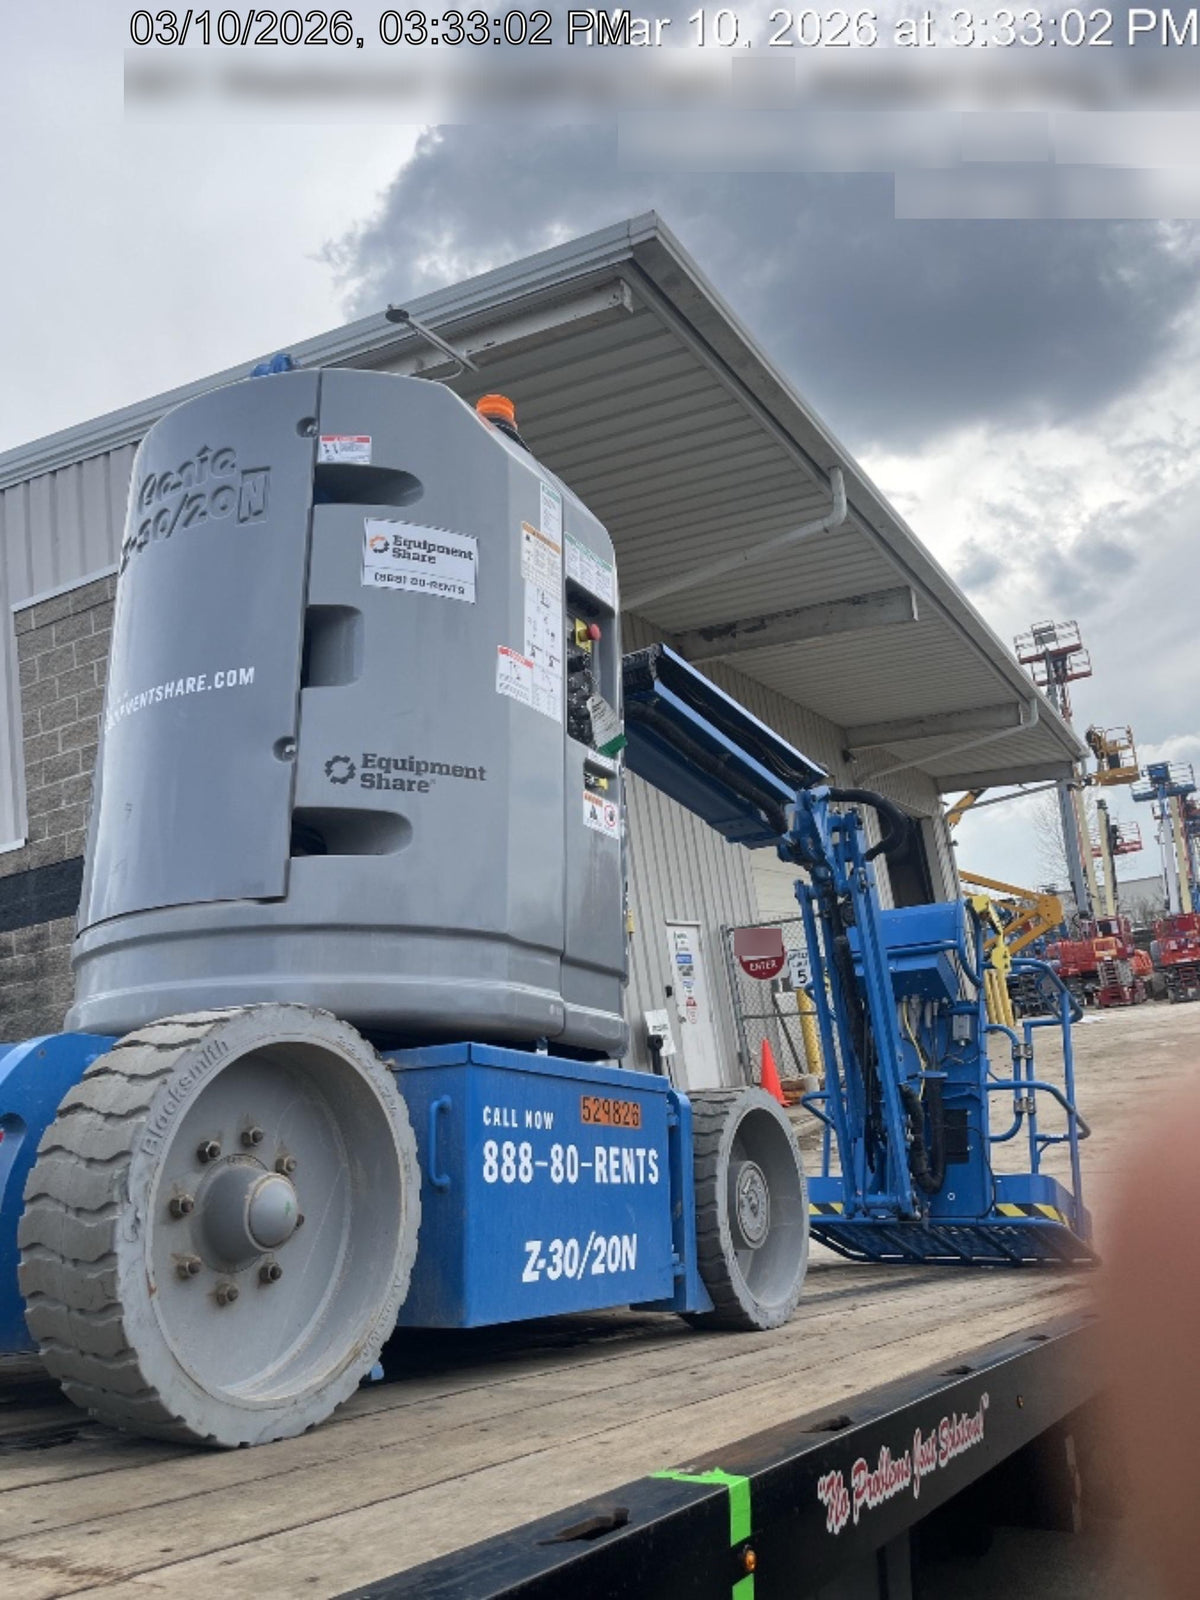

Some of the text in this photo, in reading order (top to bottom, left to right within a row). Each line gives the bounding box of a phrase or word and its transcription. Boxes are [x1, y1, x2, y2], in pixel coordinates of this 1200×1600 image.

[391, 534, 475, 561] Equipment
[391, 547, 437, 565] Share
[360, 752, 487, 782] Equipment
[359, 772, 430, 794] Share
[750, 959, 778, 972] ENTER
[797, 969, 808, 984] 5
[482, 1105, 554, 1130] CALL NOW
[581, 1096, 640, 1127] 529826
[482, 1139, 659, 1185] 888-80-RENTS
[521, 1230, 638, 1283] Z-30/20N
